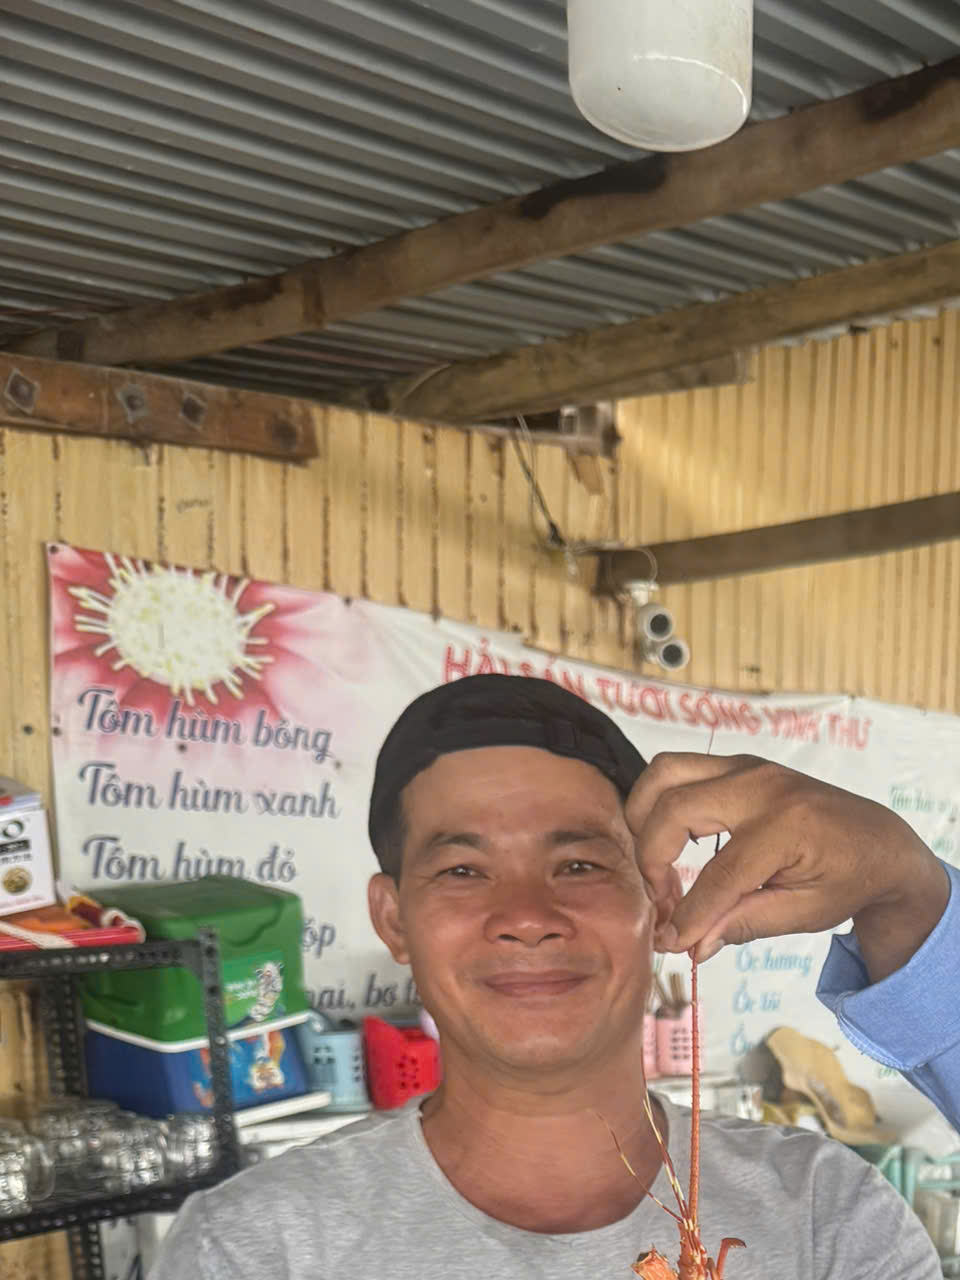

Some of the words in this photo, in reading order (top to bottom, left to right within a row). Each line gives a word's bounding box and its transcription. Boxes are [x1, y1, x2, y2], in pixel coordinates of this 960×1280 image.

[78, 688, 158, 737] Tôm
[165, 699, 248, 745] hùm
[78, 761, 162, 810] Tôm
[167, 770, 249, 814] hùm
[252, 781, 341, 819] xanh
[81, 834, 165, 881] Tôm
[171, 841, 252, 882] hùm
[256, 844, 298, 883] đỏ
